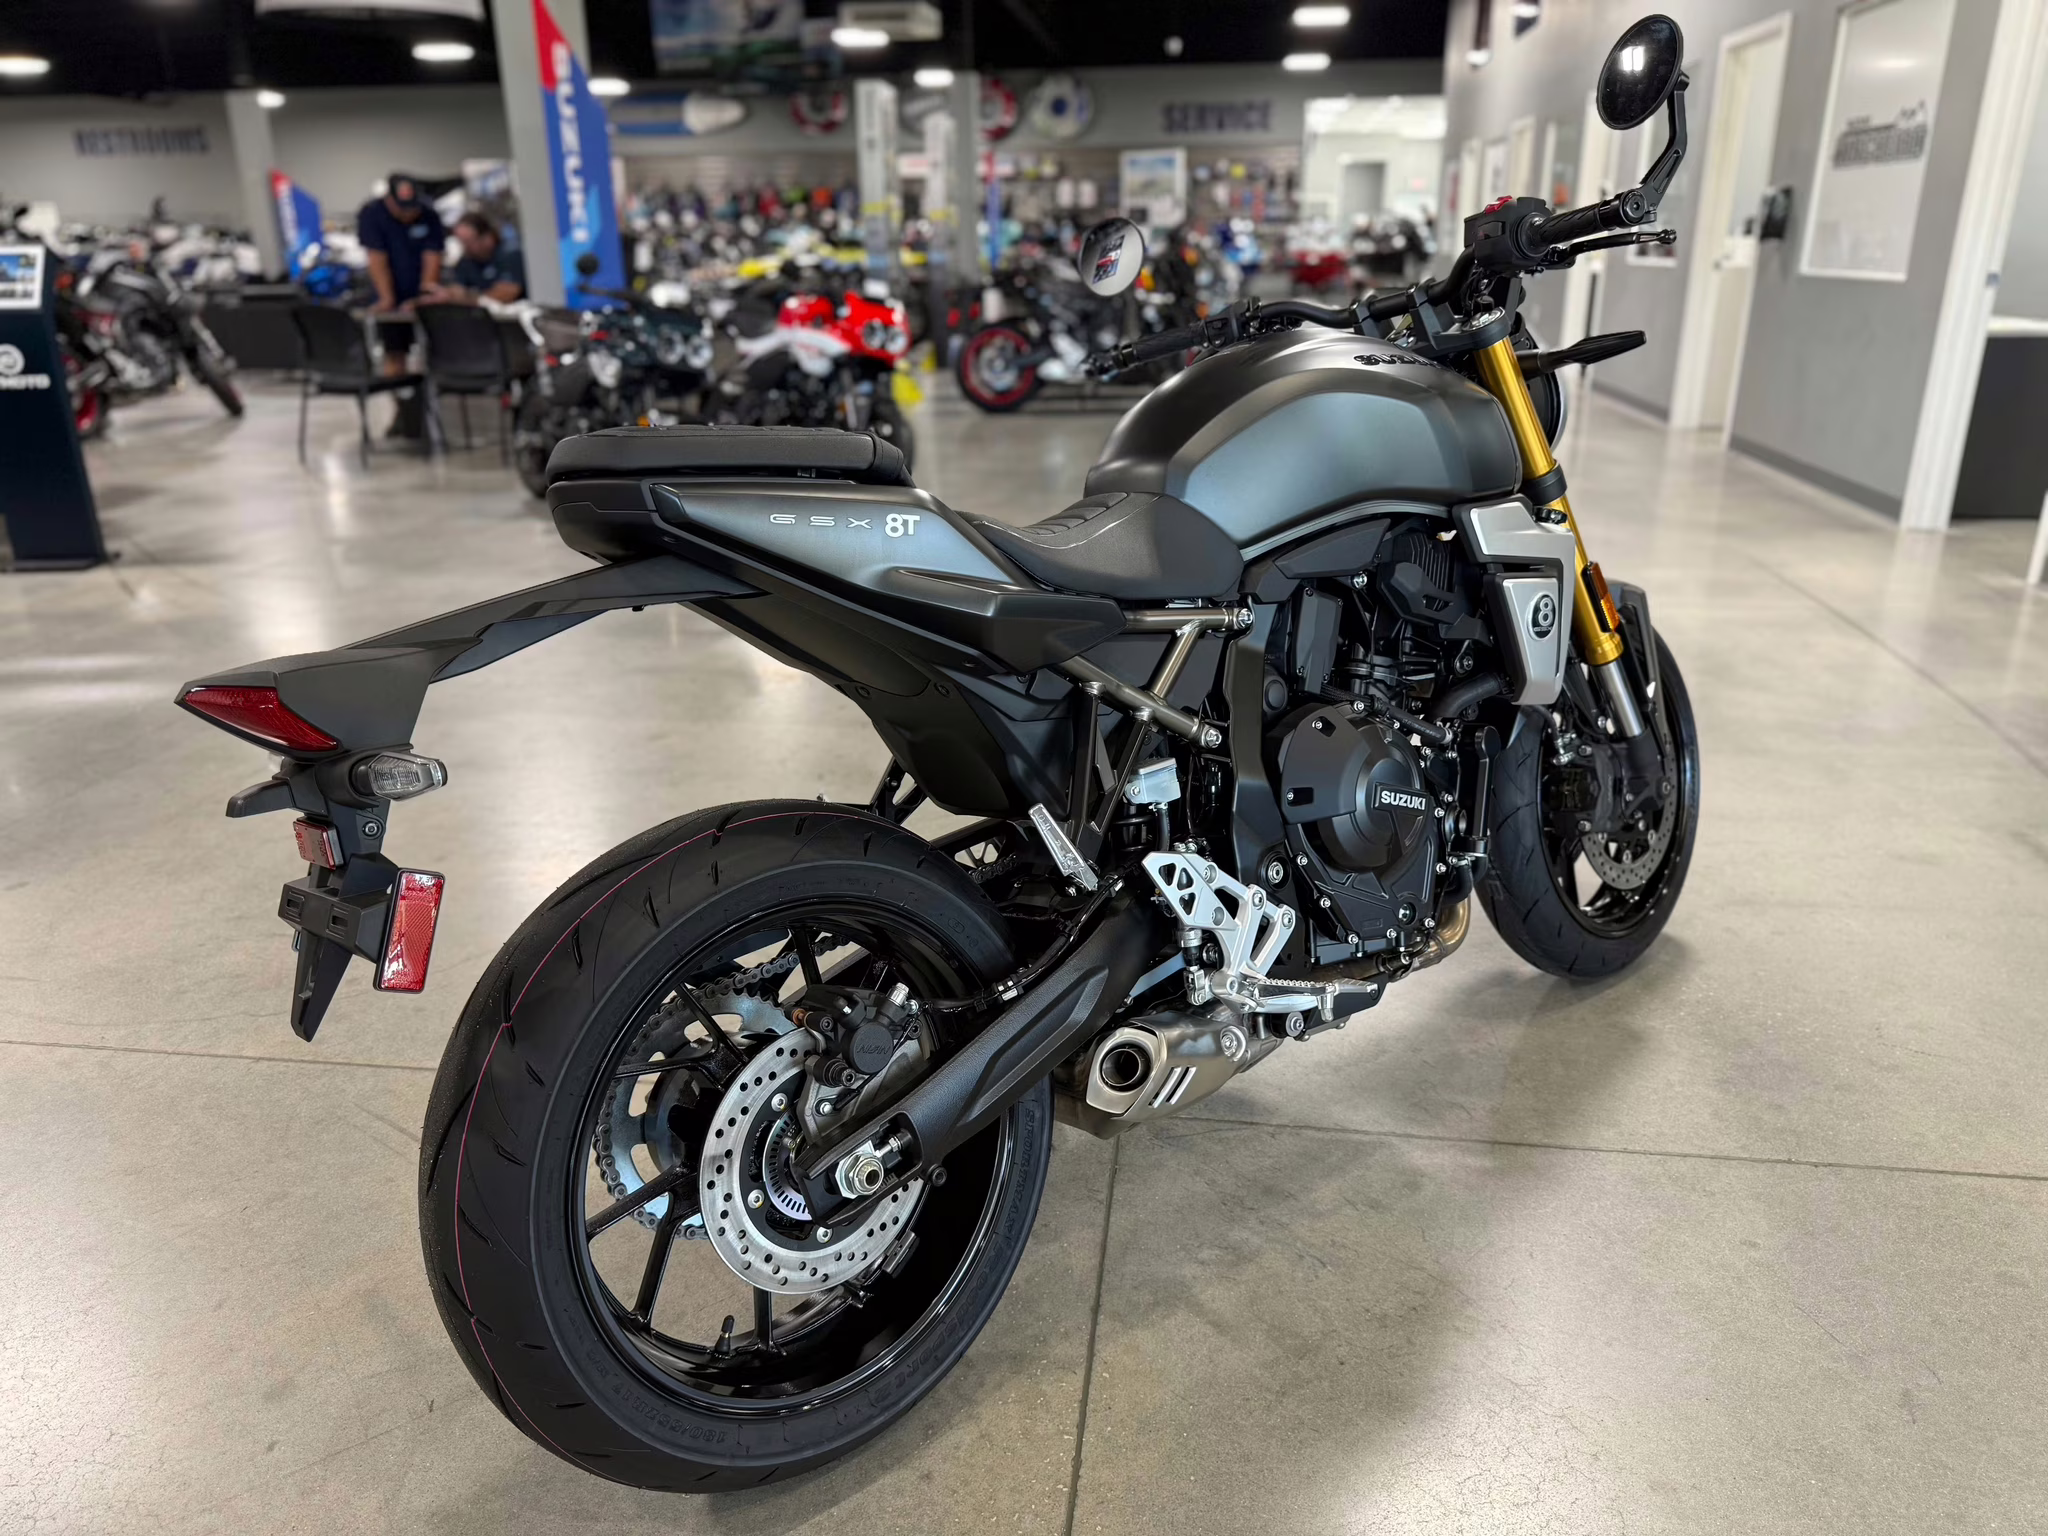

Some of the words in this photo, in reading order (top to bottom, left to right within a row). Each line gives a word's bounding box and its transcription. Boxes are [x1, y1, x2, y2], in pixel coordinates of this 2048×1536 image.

[1163, 101, 1272, 132] SERVICE
[551, 41, 589, 243] SUZUKI
[769, 513, 872, 529] GSX
[885, 513, 921, 538] 8T
[1538, 597, 1554, 626] 8
[1380, 790, 1426, 810] SUZUKI
[1006, 1109, 1036, 1234] SPORTMAX
